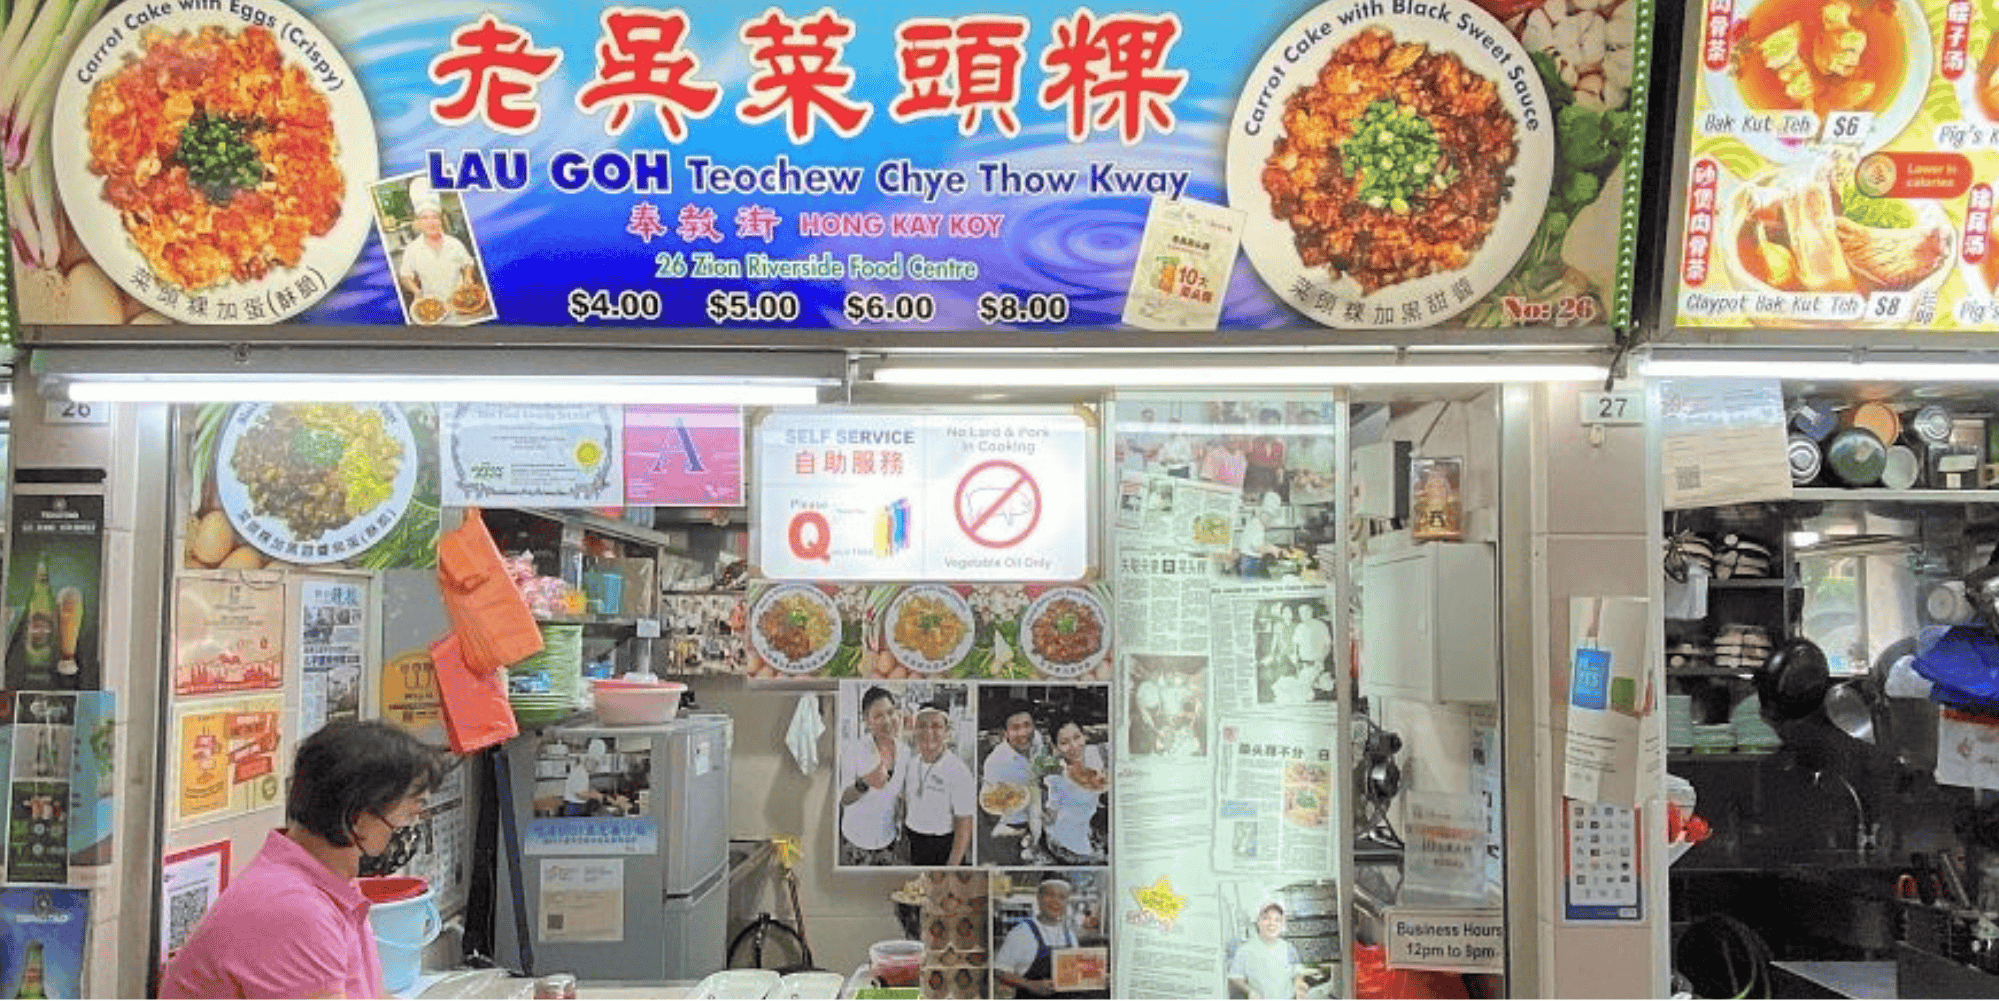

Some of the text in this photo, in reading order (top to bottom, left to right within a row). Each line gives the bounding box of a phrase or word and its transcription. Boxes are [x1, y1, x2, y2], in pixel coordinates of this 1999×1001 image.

[78, 27, 124, 84] Carrot
[124, 1, 171, 31] Cake
[229, 0, 276, 27] Eggs
[280, 22, 344, 92] (Crispy)
[1244, 0, 1539, 136] Carrot Cake with Black Sweet Sauce
[1833, 116, 1860, 137] $6
[428, 151, 1188, 202] LAU GOH Teochew Chye Thow Kway
[800, 213, 1004, 238] HONG KAY KOY
[655, 252, 979, 281] 26 Zion Riverside Food Centre
[568, 288, 1068, 323] $4.00 $5.00 $6.00 $8.00
[1503, 296, 1597, 321] No: 26
[1598, 397, 1628, 418] 27
[786, 428, 916, 445] SELF SERVICE
[946, 426, 966, 438] No
[650, 416, 706, 475] A
[978, 440, 1037, 456] Cooking
[788, 510, 831, 564] Q
[1396, 921, 1459, 937] Business
[1447, 945, 1462, 957] to
